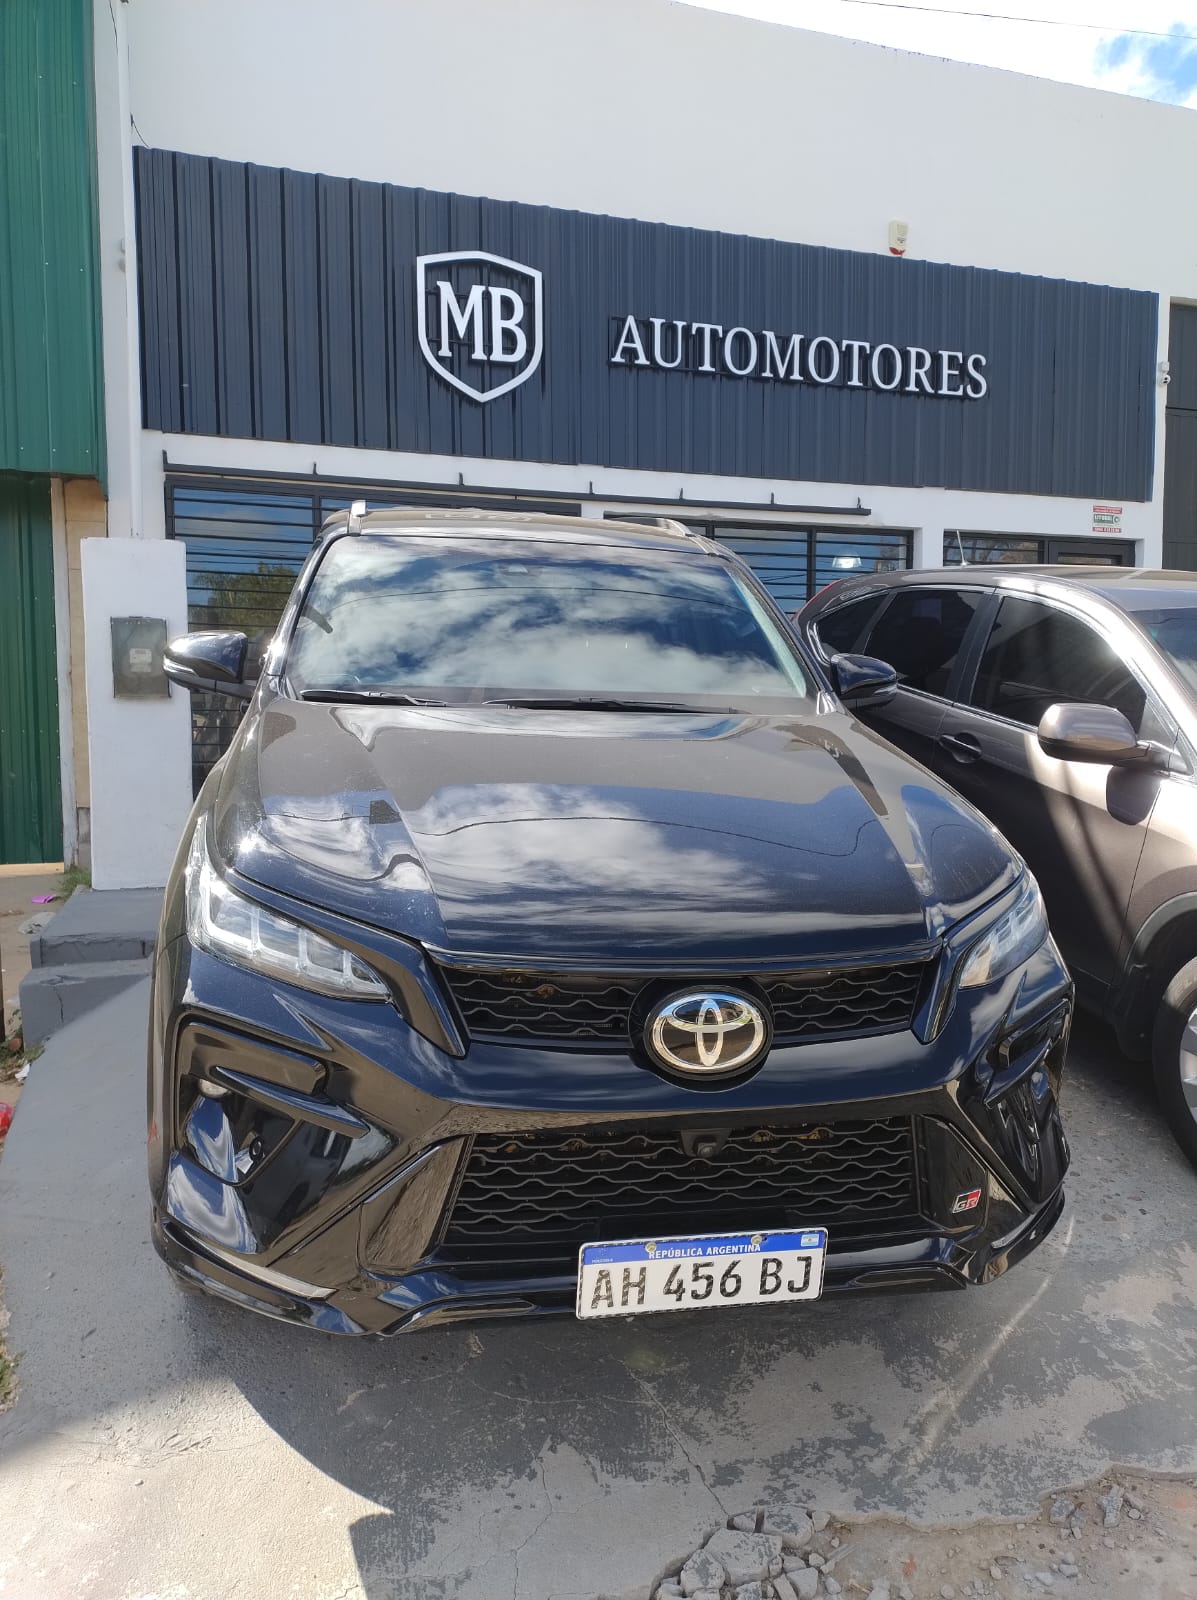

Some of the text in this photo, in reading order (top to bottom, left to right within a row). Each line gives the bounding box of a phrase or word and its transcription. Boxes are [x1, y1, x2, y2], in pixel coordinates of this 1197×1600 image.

[437, 281, 526, 362] MB
[611, 315, 988, 399] AUTOMOTORES
[591, 1256, 812, 1309] AH 456 BJ
[648, 1244, 761, 1259] REPÚBLICA ARGENTINA
